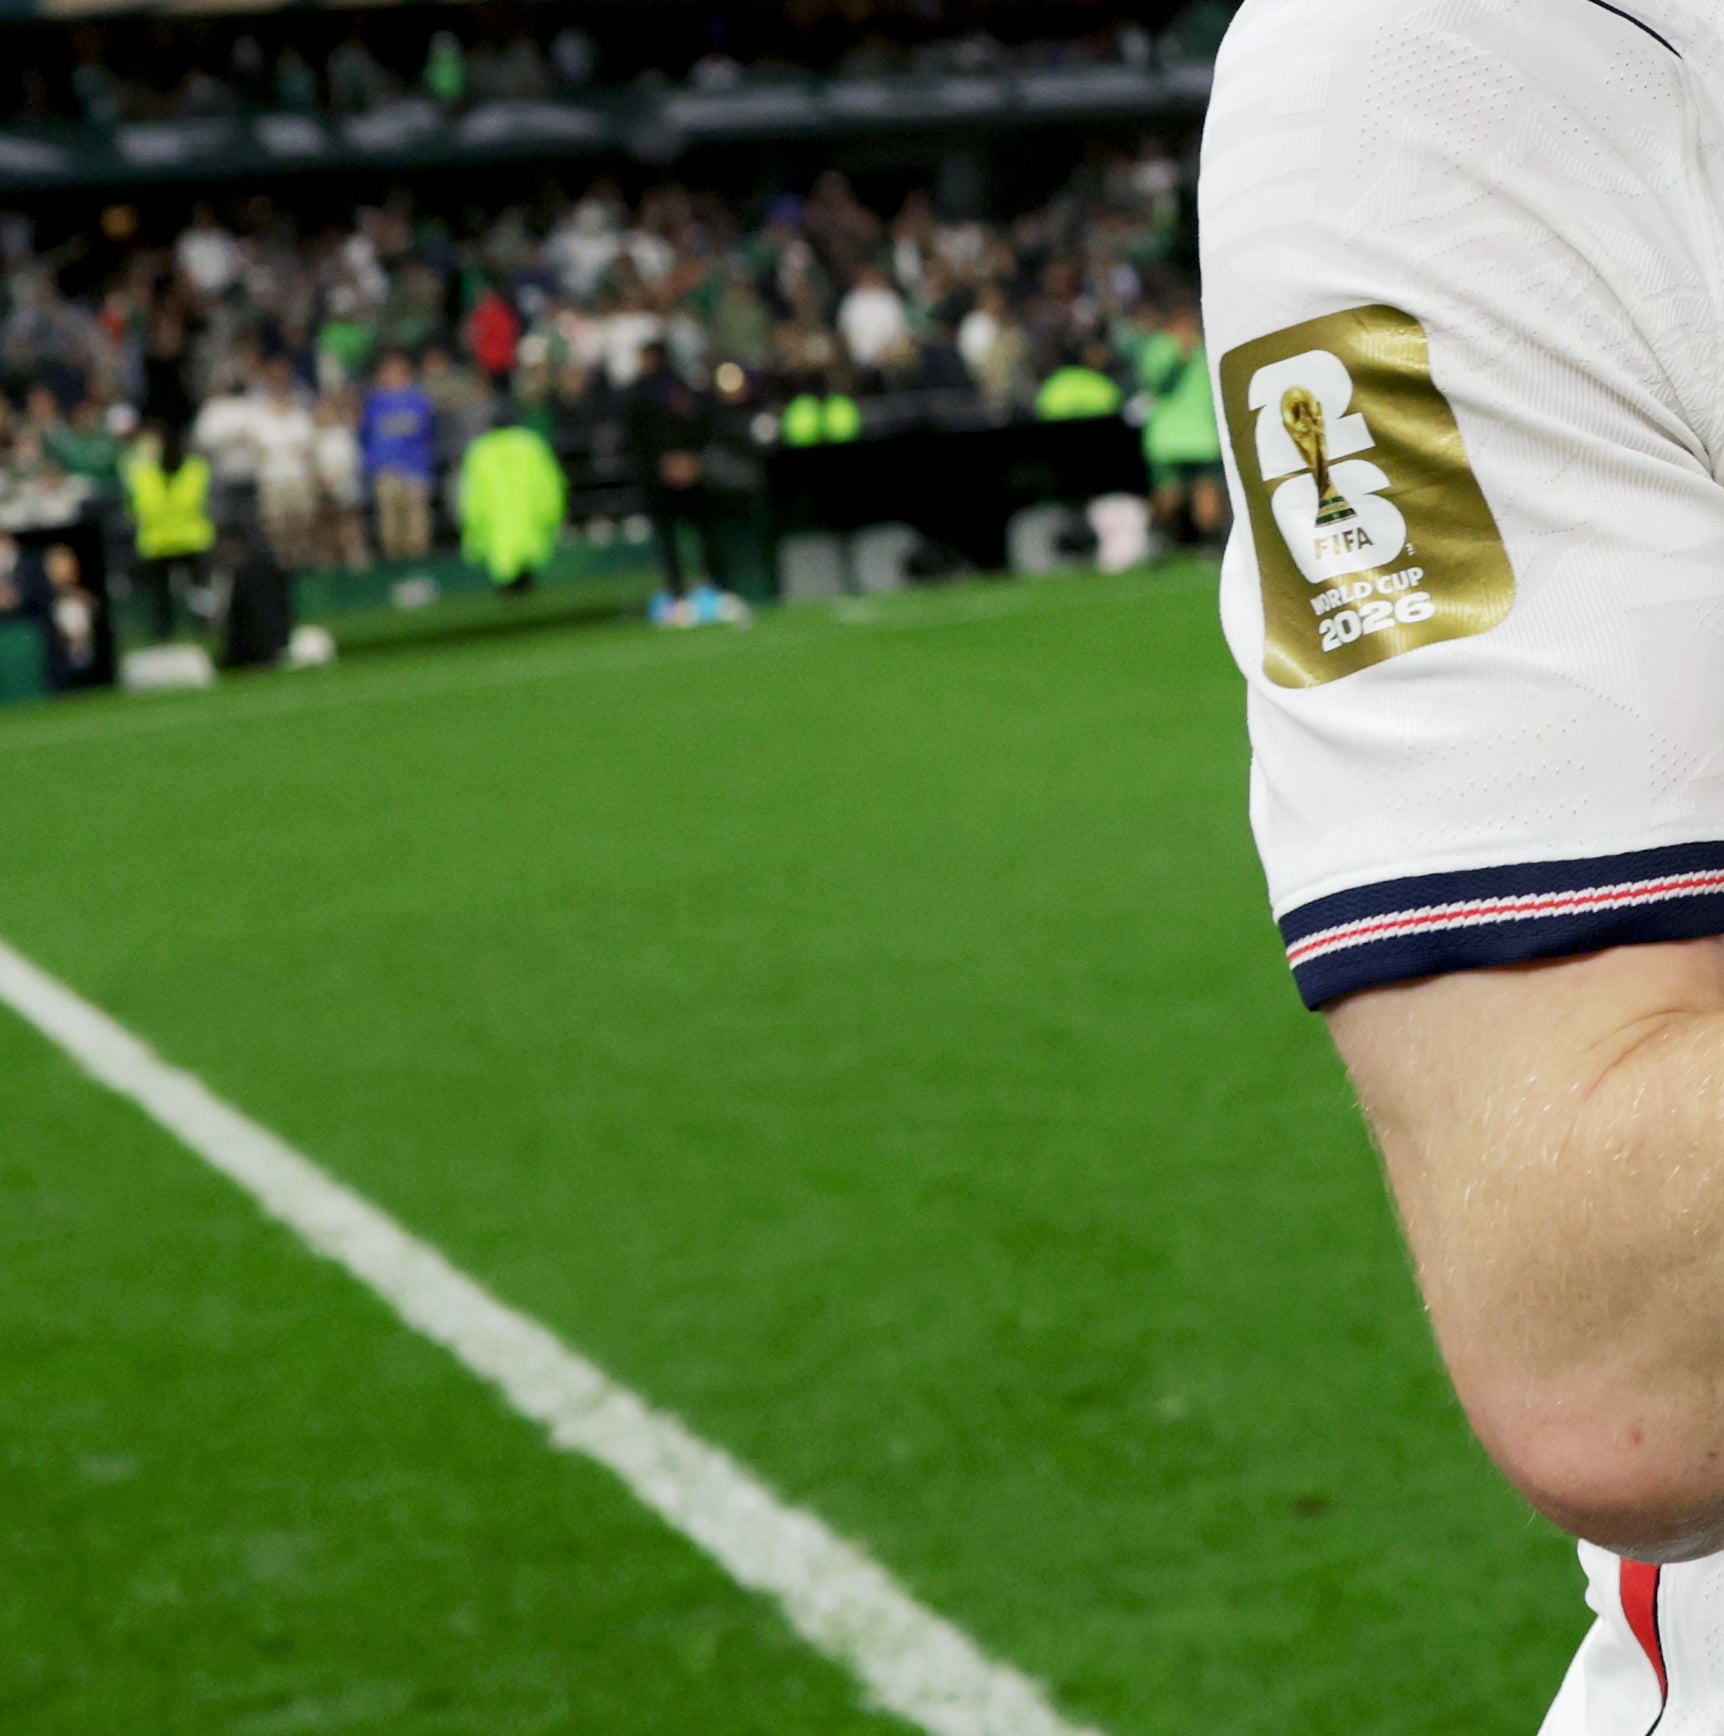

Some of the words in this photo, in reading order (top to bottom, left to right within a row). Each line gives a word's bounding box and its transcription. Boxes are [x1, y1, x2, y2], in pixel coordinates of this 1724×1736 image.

[1313, 526, 1374, 561] FIFA
[1310, 581, 1373, 615] WORLD
[1376, 567, 1424, 595] CUP
[1318, 591, 1435, 652] 2026
